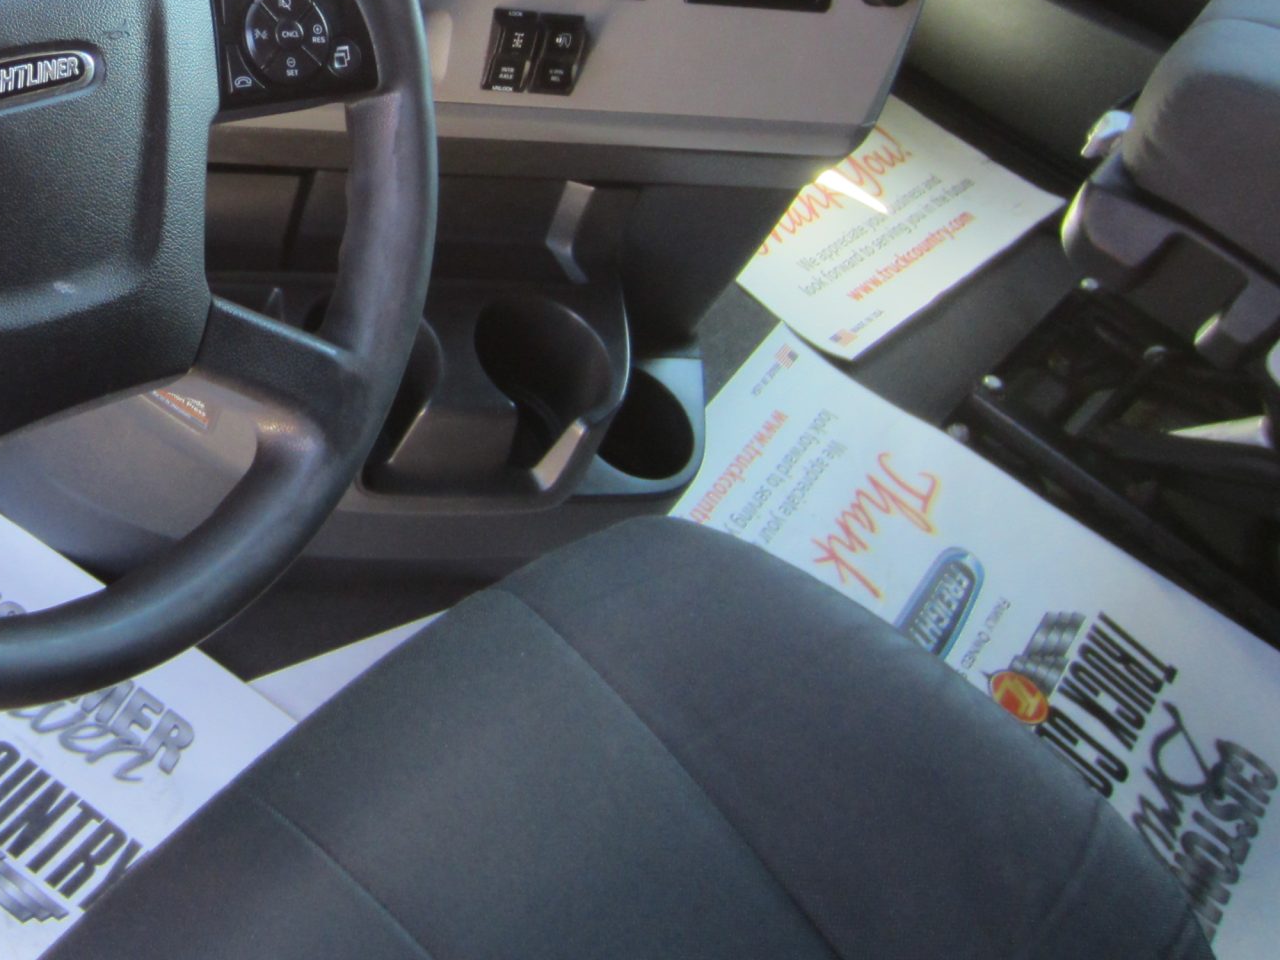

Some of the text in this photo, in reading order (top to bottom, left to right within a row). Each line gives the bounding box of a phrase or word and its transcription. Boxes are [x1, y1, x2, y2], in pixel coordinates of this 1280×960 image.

[312, 36, 326, 44] RES
[286, 69, 299, 77] SET
[846, 209, 976, 299] www.truckcountry.com
[807, 407, 838, 437] look
[765, 470, 785, 490] to
[774, 429, 820, 479] forward
[728, 480, 777, 533] serving
[758, 439, 847, 544] We appreciate your
[812, 451, 939, 600] Thank
[1058, 611, 1178, 752] TRUCK
[1170, 739, 1279, 945] CUSTOM
